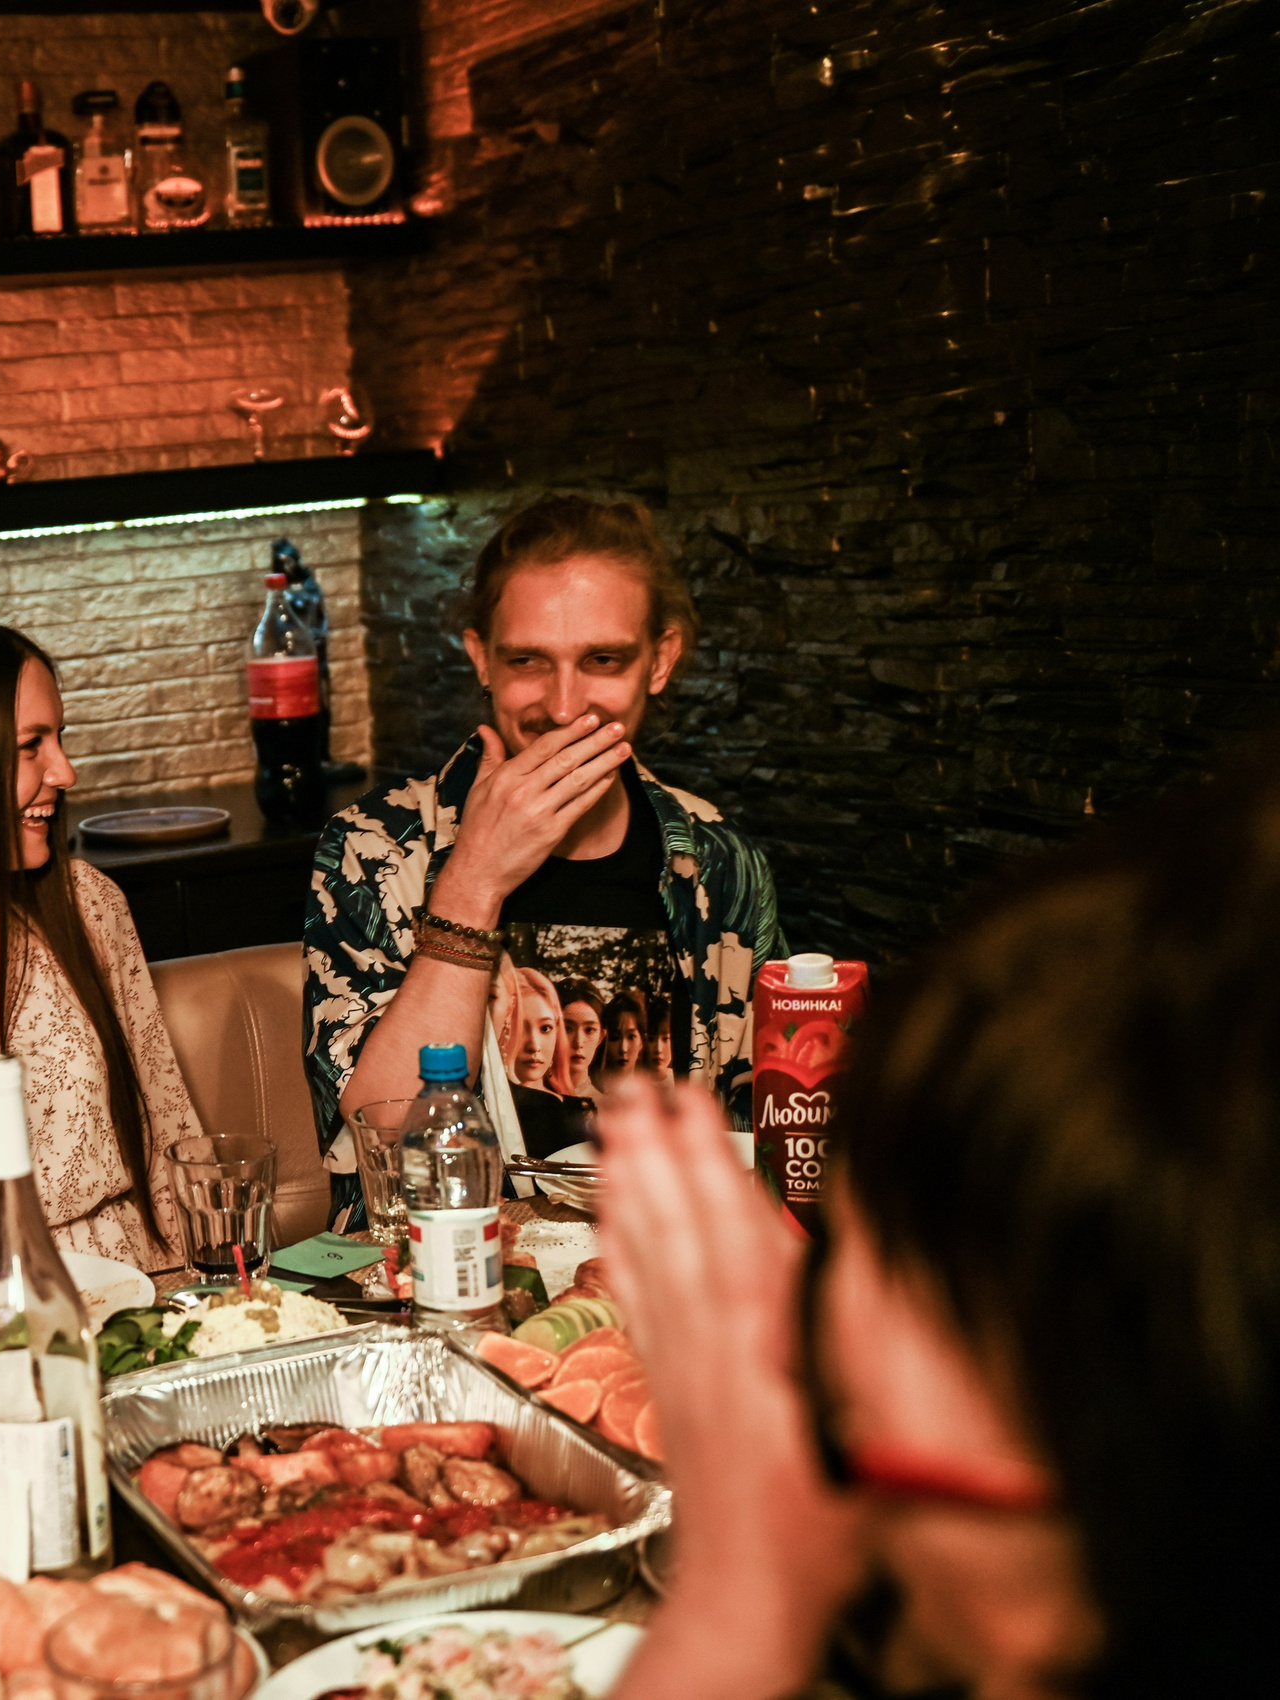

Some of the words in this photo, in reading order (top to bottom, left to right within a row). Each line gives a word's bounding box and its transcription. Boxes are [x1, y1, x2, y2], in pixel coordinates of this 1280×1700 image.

[771, 998, 843, 1012] НОВИНКА!
[785, 1159, 826, 1178] СО
[785, 1178, 824, 1191] ТОМ
